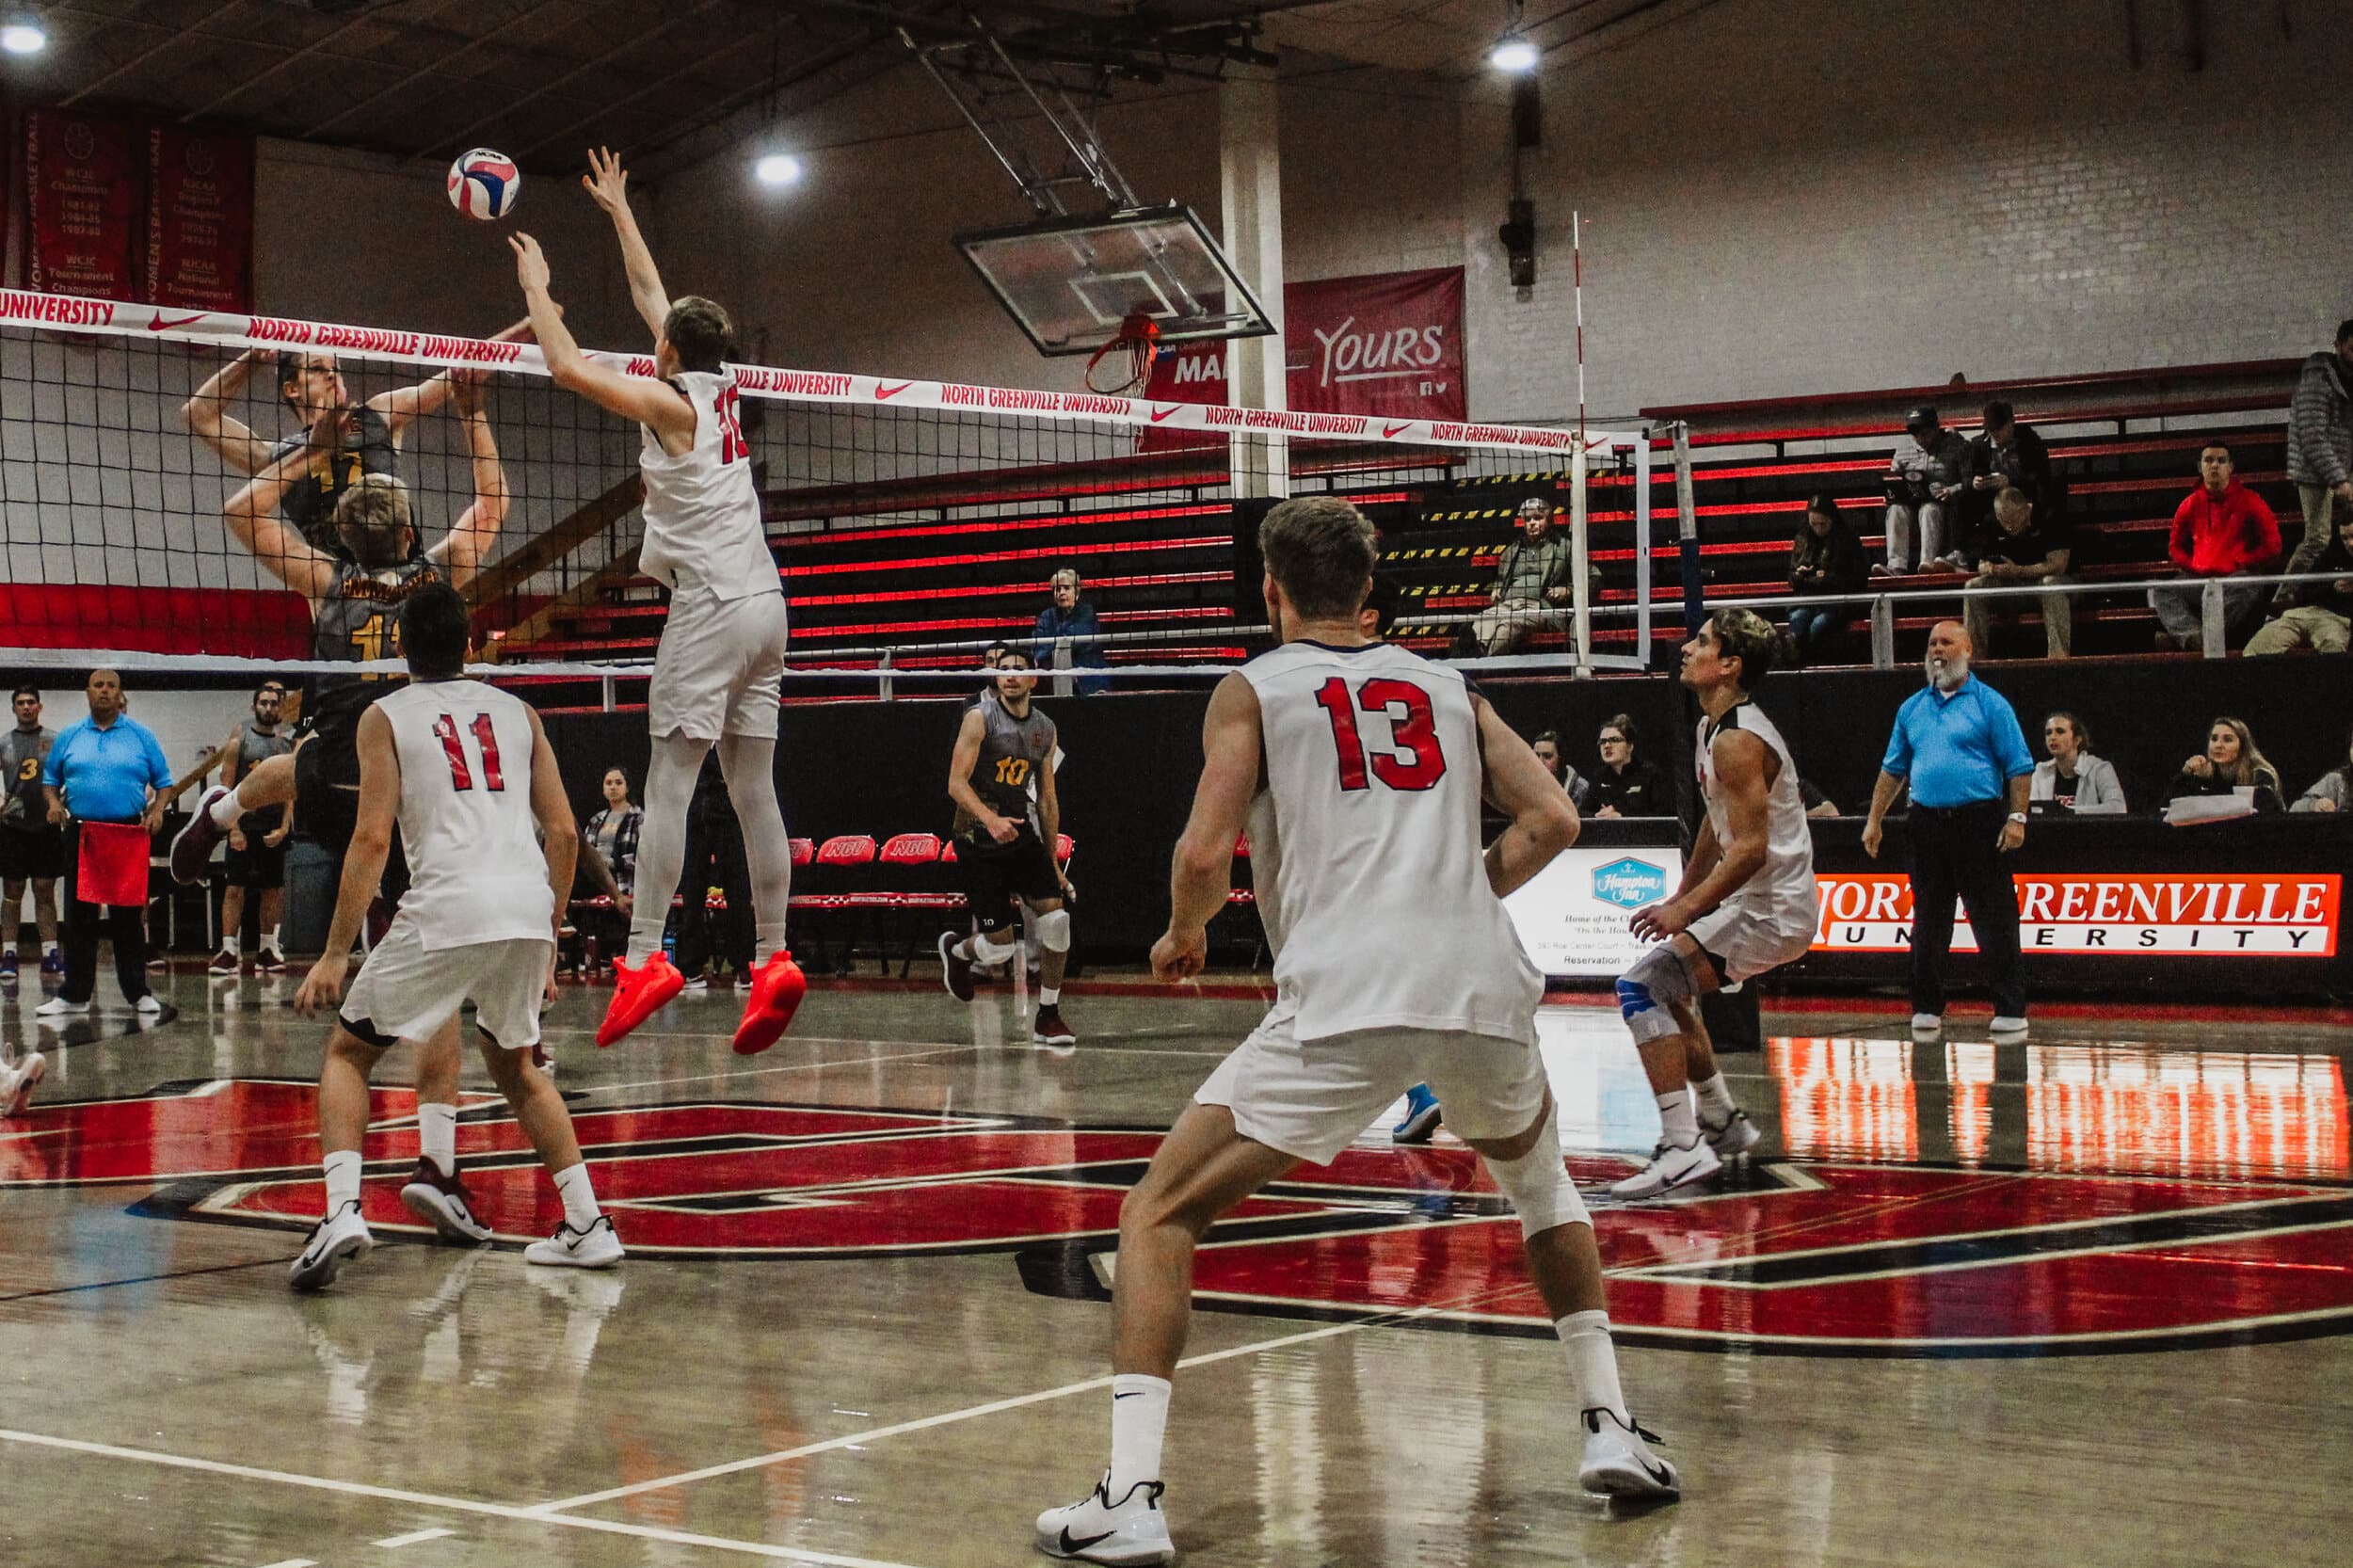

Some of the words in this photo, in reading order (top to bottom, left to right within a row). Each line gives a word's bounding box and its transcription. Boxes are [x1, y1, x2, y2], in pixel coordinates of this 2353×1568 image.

[48, 267, 115, 281] Tournament
[51, 282, 111, 296] Champions
[0, 294, 114, 326] UNIVERSITY
[246, 318, 312, 344] NORTH
[315, 326, 419, 356] GREENVILLE
[423, 336, 520, 363] UNIVERSITY
[1314, 316, 1443, 388] YOURS
[772, 372, 852, 395] UNIVERSITY
[941, 384, 984, 406] NORTH
[989, 389, 1060, 411] GREENVILLE
[1063, 392, 1130, 415] UNIVERSITY
[1206, 407, 1242, 425] NORTH
[1246, 410, 1306, 431] GREENVILLE
[1308, 413, 1368, 434] UNIVERSITY
[1431, 424, 1464, 440] NORTH
[1465, 426, 1518, 443] GREENVILLE
[1520, 429, 1569, 449] UNIVERSITY
[301, 715, 314, 728] 17
[1314, 676, 1447, 792] 13
[431, 712, 504, 792] 11
[18, 757, 39, 781] 3
[994, 755, 1031, 787] 10
[825, 841, 868, 857] NGU
[890, 839, 931, 856] NGU
[1597, 872, 1661, 891] Hampton
[1612, 888, 1645, 903] Inn
[2012, 882, 2328, 923] REENVILLE
[983, 919, 995, 927] 10
[1564, 914, 1590, 923] Home
[1593, 914, 1602, 926] of
[1603, 914, 1619, 924] the
[1563, 955, 1621, 965] Reservation
